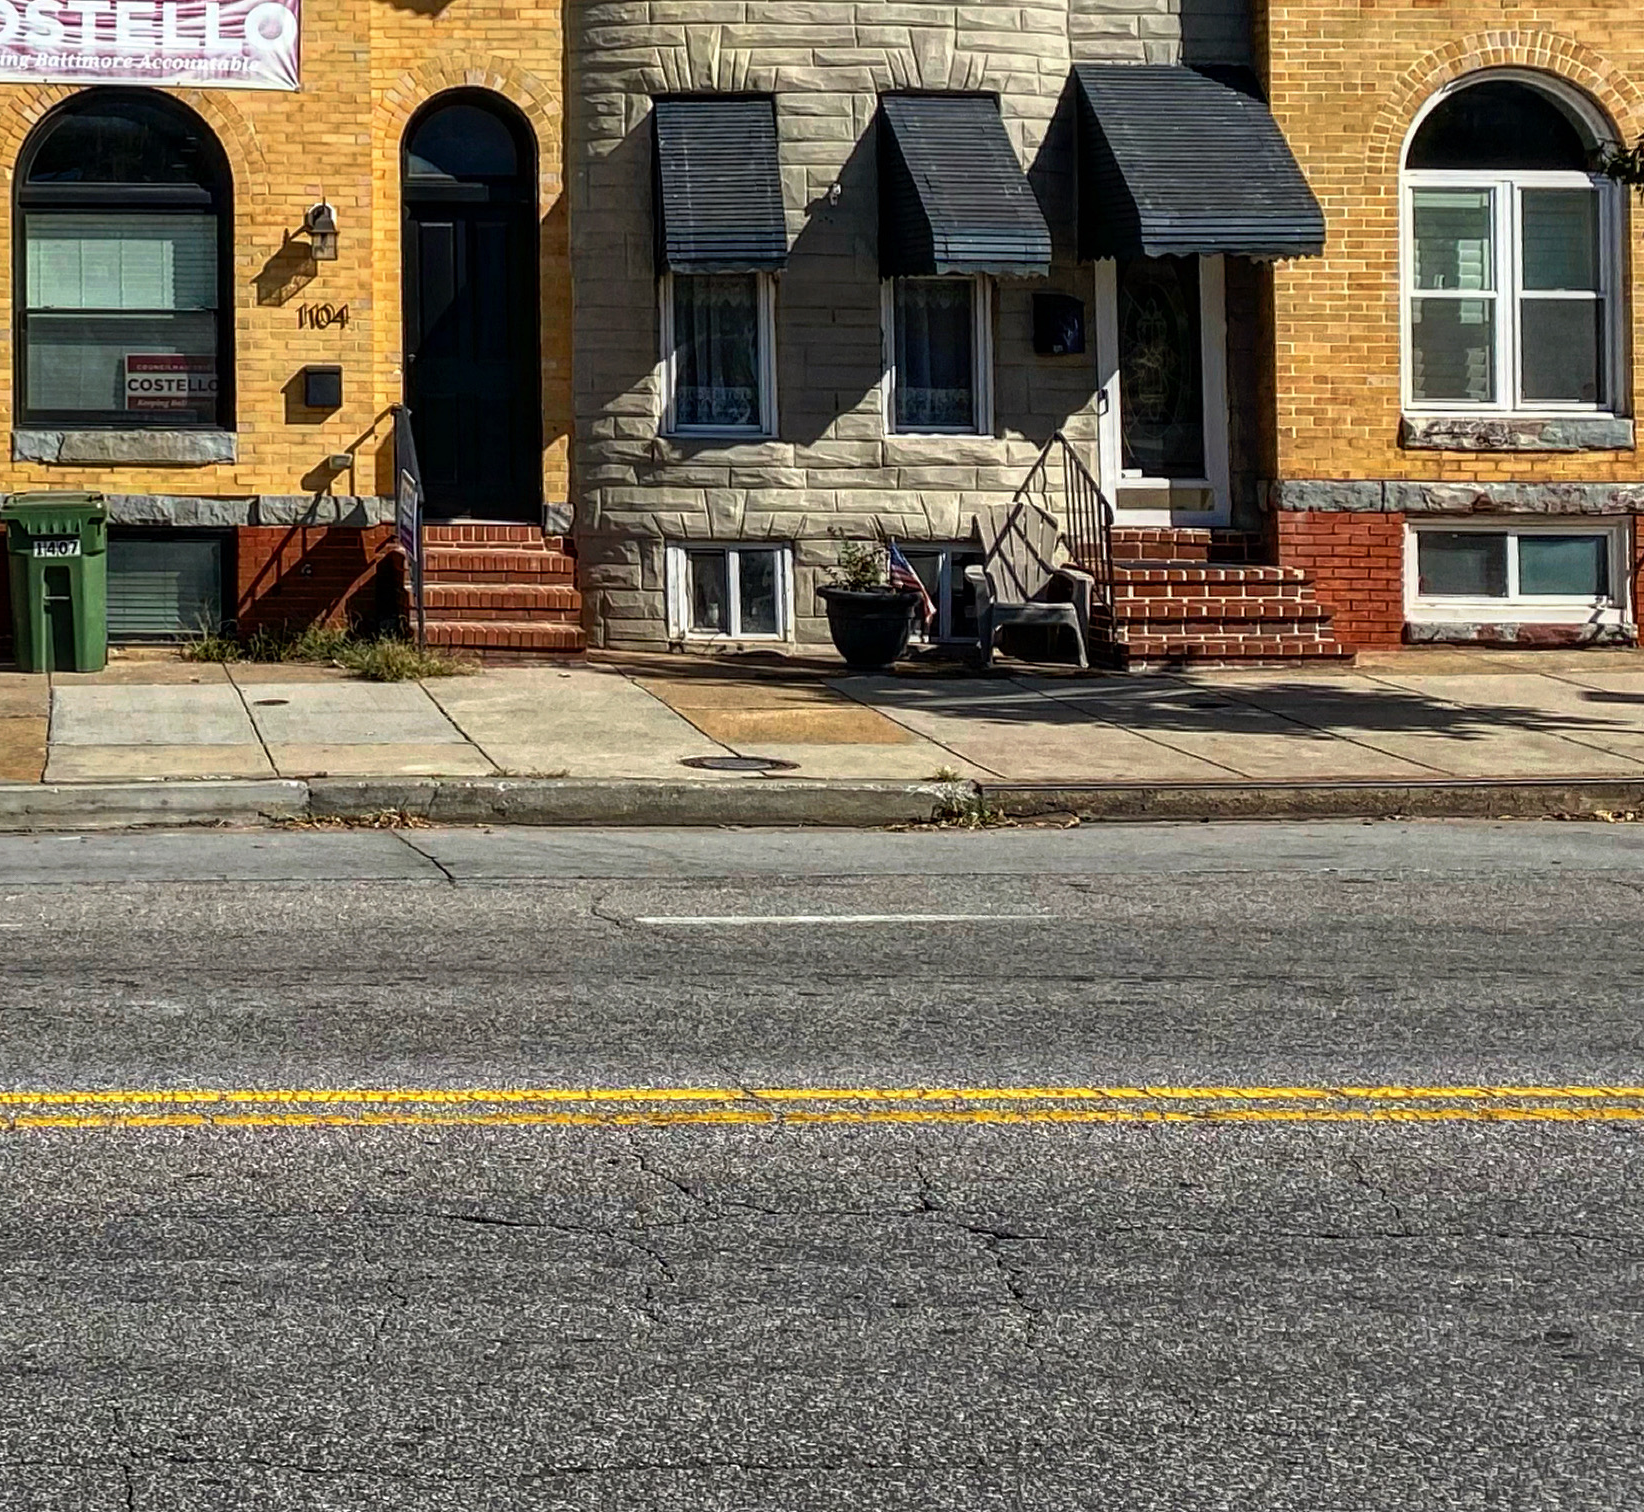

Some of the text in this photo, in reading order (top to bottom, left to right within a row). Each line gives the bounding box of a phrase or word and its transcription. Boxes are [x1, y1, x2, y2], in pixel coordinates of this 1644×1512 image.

[34, 52, 135, 69] Baltimore
[296, 302, 350, 329] 1104
[127, 378, 219, 392] COSTELLO
[36, 540, 78, 556] 1407
